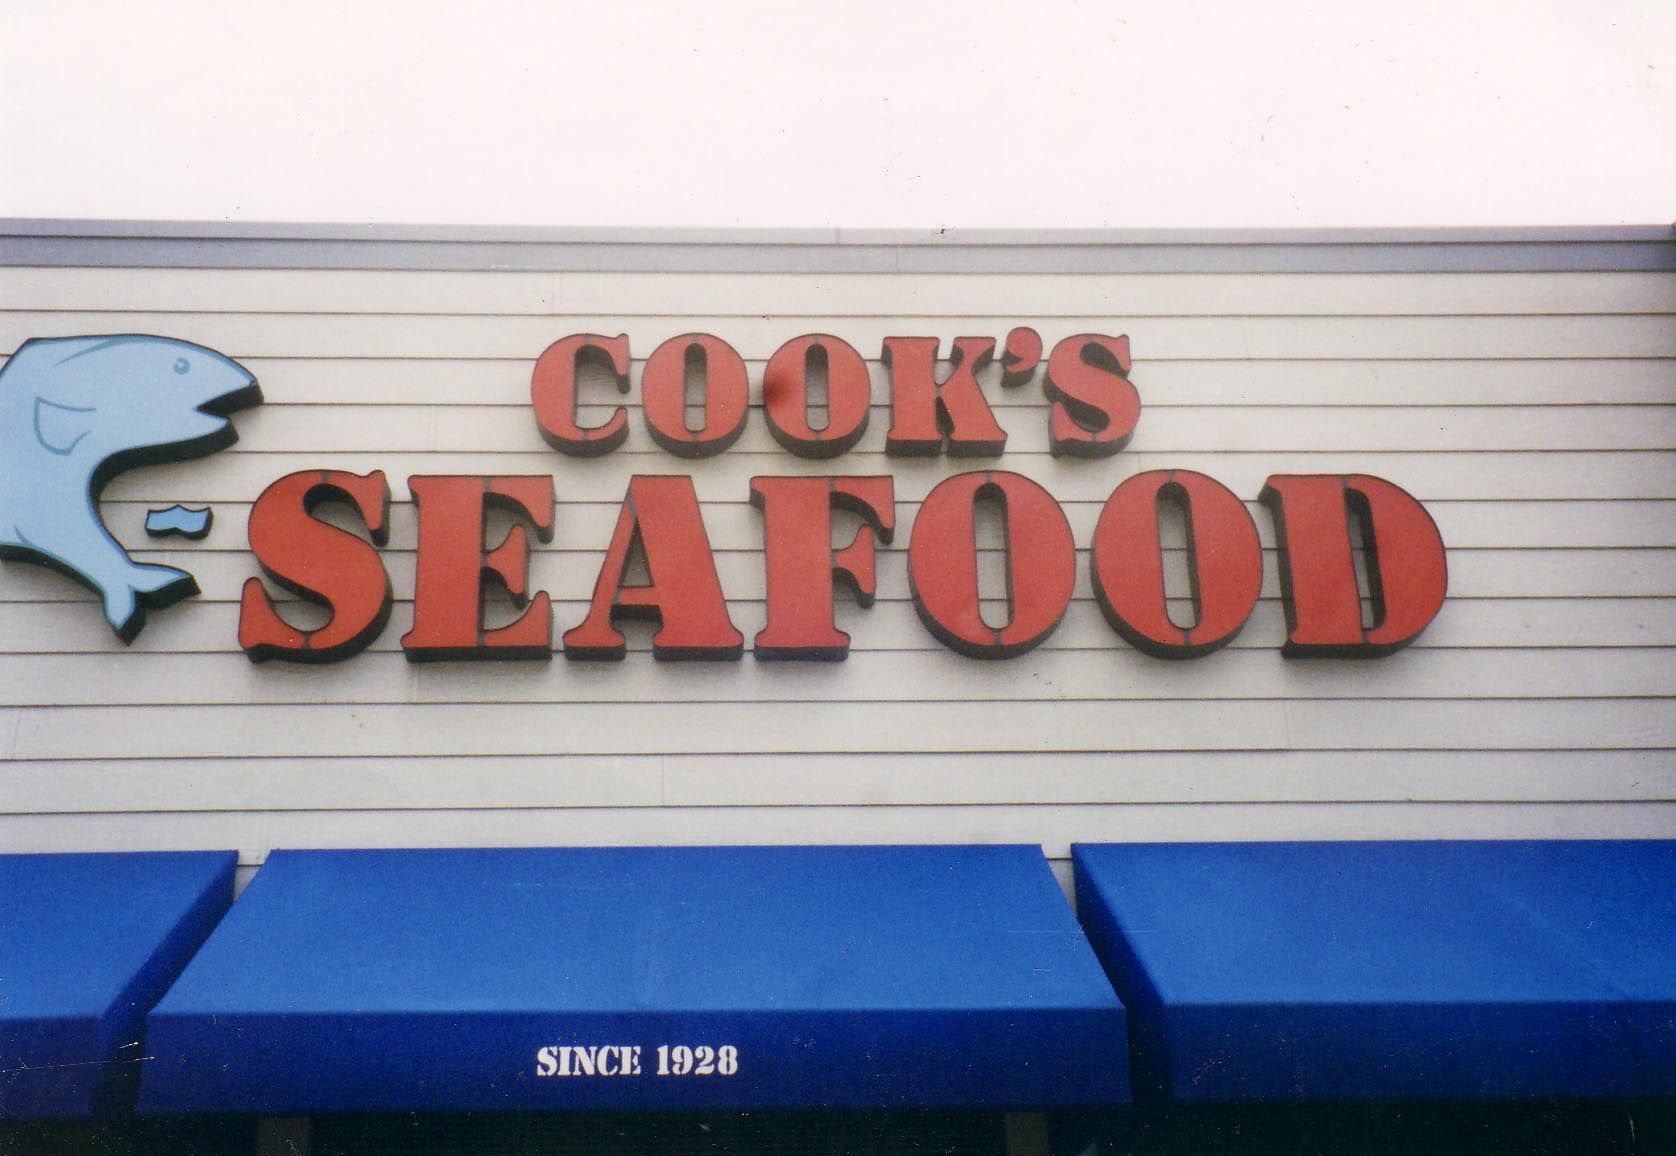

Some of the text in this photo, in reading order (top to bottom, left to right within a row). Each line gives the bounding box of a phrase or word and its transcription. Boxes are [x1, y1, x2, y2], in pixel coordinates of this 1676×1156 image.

[531, 328, 1141, 444] COOK'S
[239, 471, 1447, 650] SEAFOOD
[536, 1044, 739, 1077] SINCE 1928
